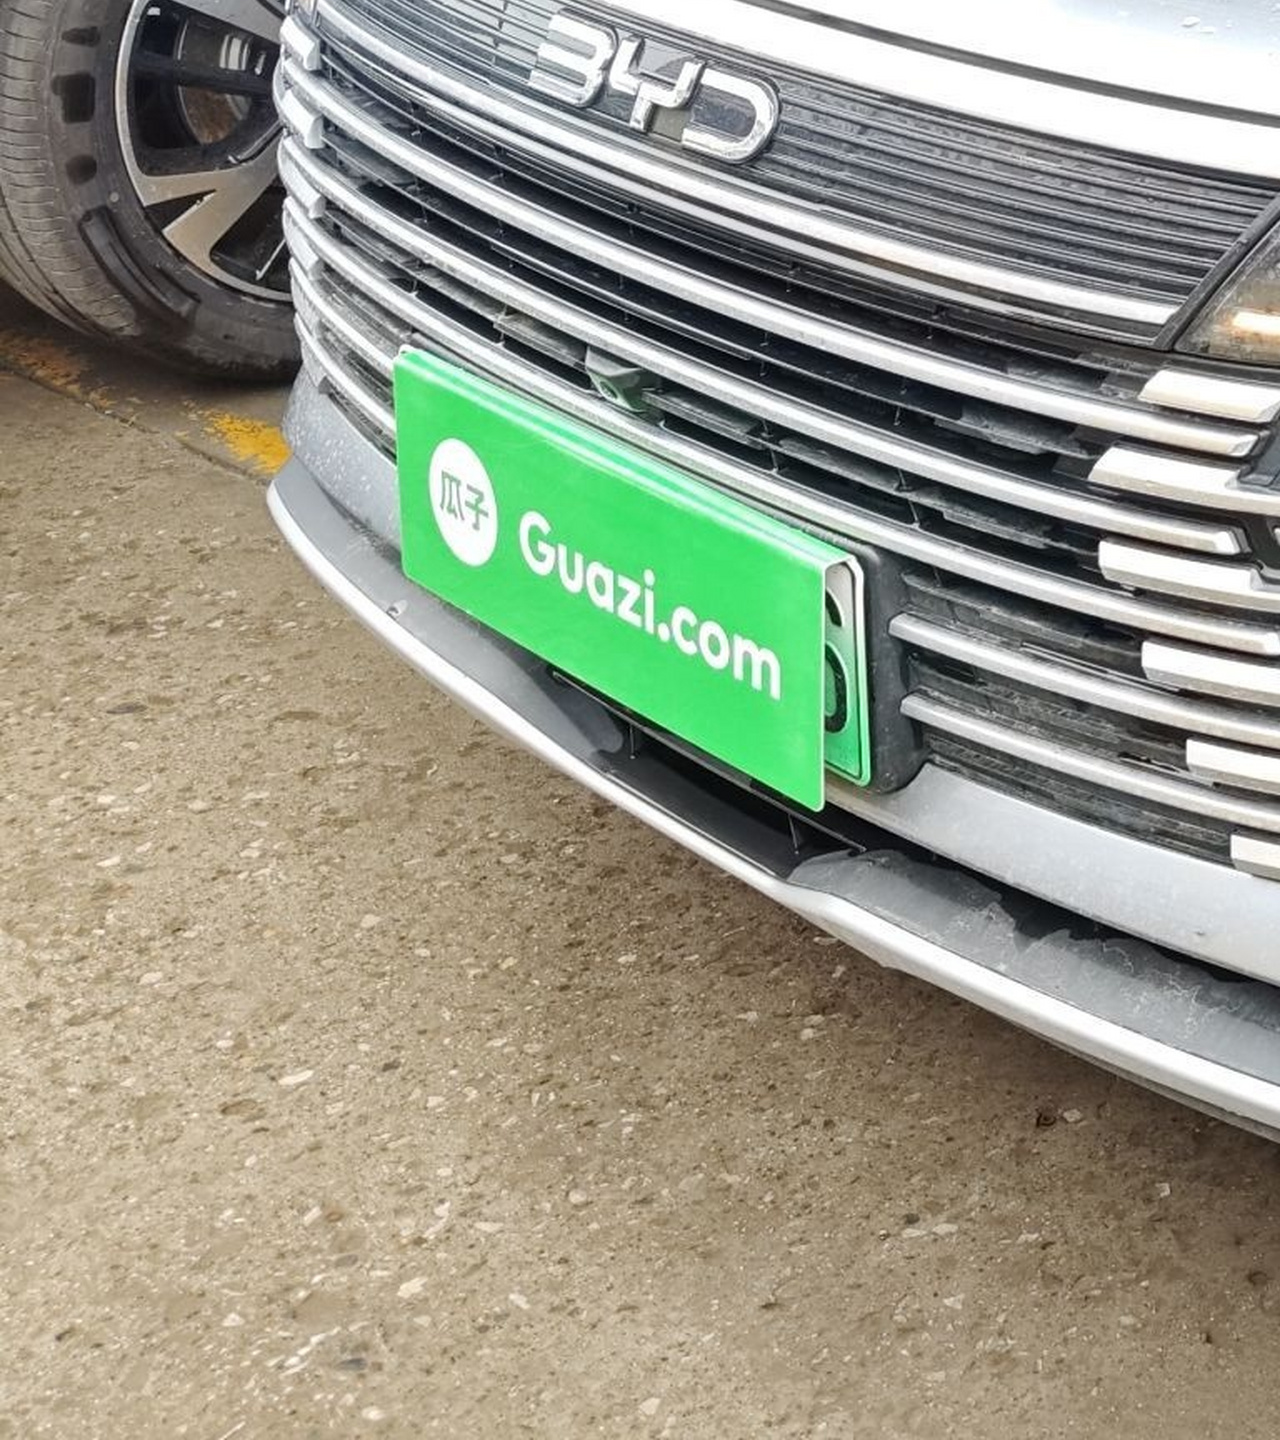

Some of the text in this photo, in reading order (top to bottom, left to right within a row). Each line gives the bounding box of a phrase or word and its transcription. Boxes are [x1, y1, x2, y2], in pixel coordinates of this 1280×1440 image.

[527, 8, 781, 165] BYD
[440, 469, 489, 532] 瓜子
[518, 510, 781, 702] Guazi.com
